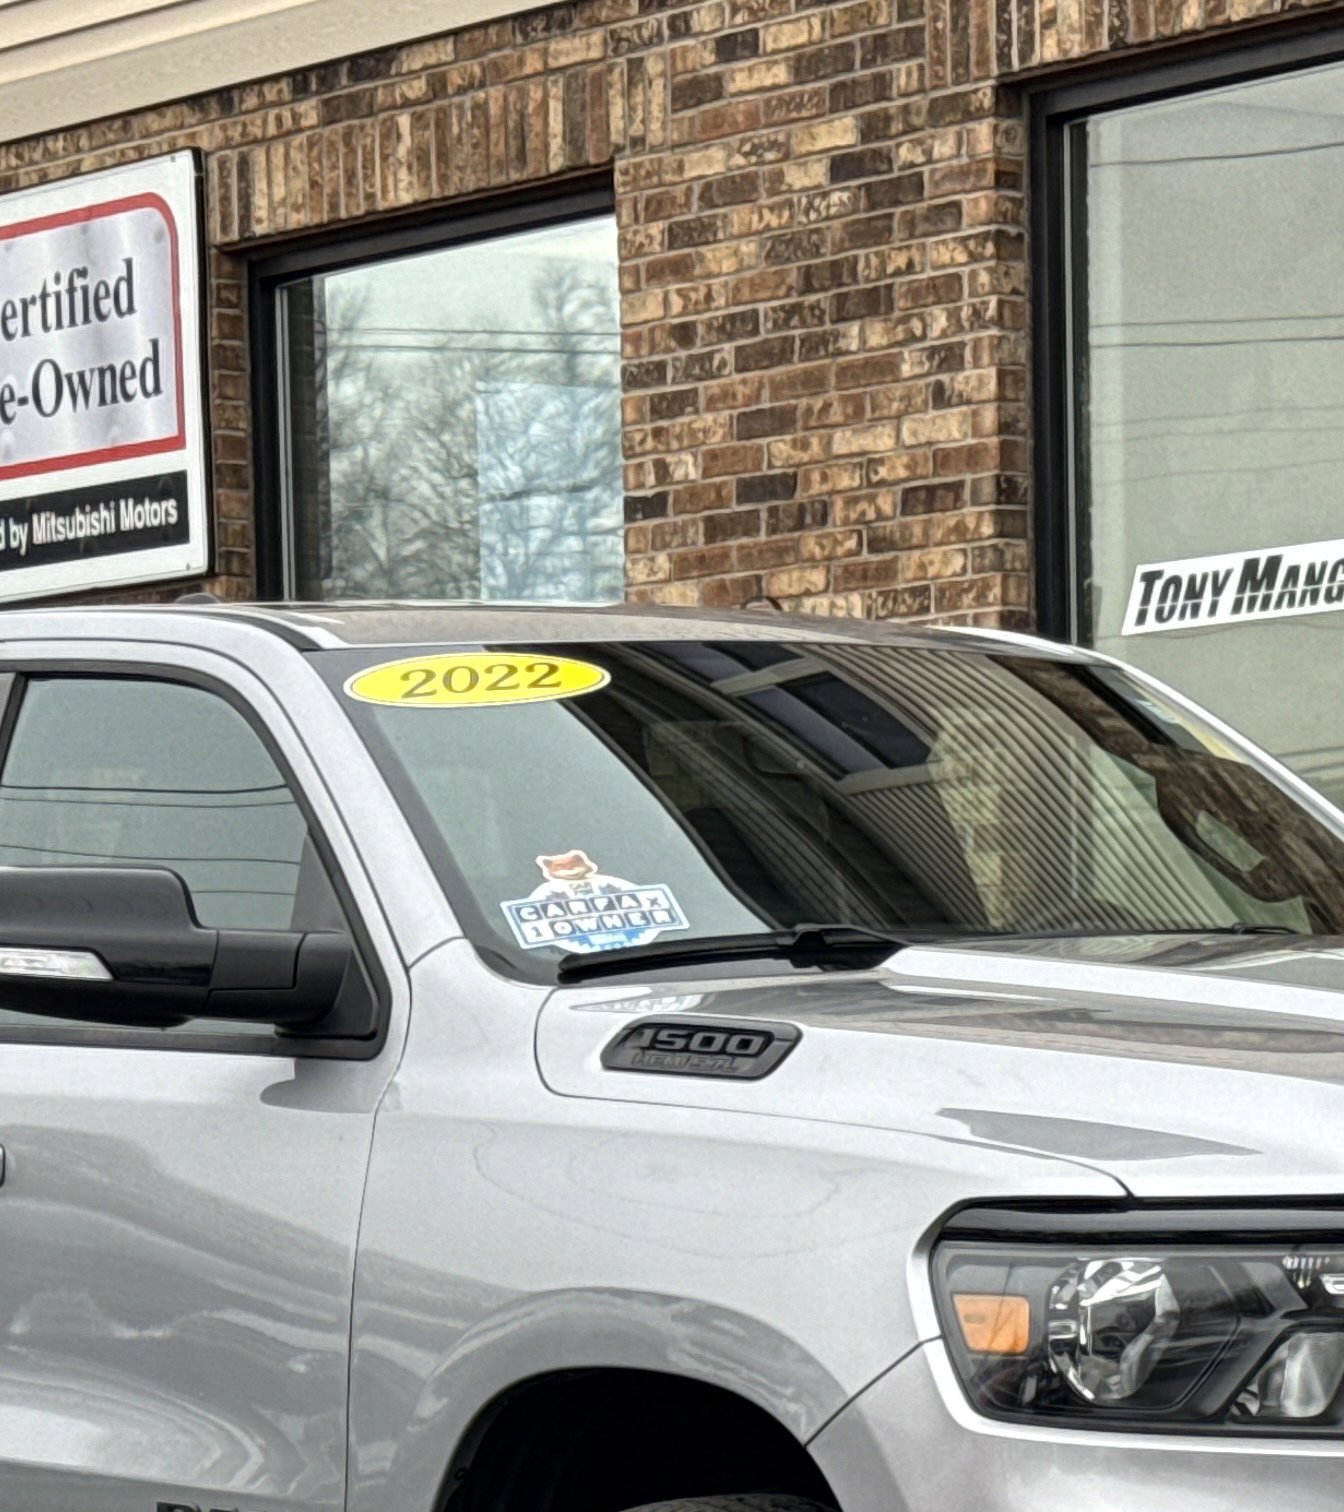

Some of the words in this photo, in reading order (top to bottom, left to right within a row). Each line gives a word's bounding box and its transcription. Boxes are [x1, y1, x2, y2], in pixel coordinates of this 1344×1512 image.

[9, 517, 29, 557] by
[32, 502, 116, 545] Mitsubishi
[120, 497, 178, 531] Motors
[400, 662, 563, 700] 2022
[517, 893, 665, 923] CARFAX
[552, 910, 674, 936] OWNER
[624, 1028, 766, 1056] 1500
